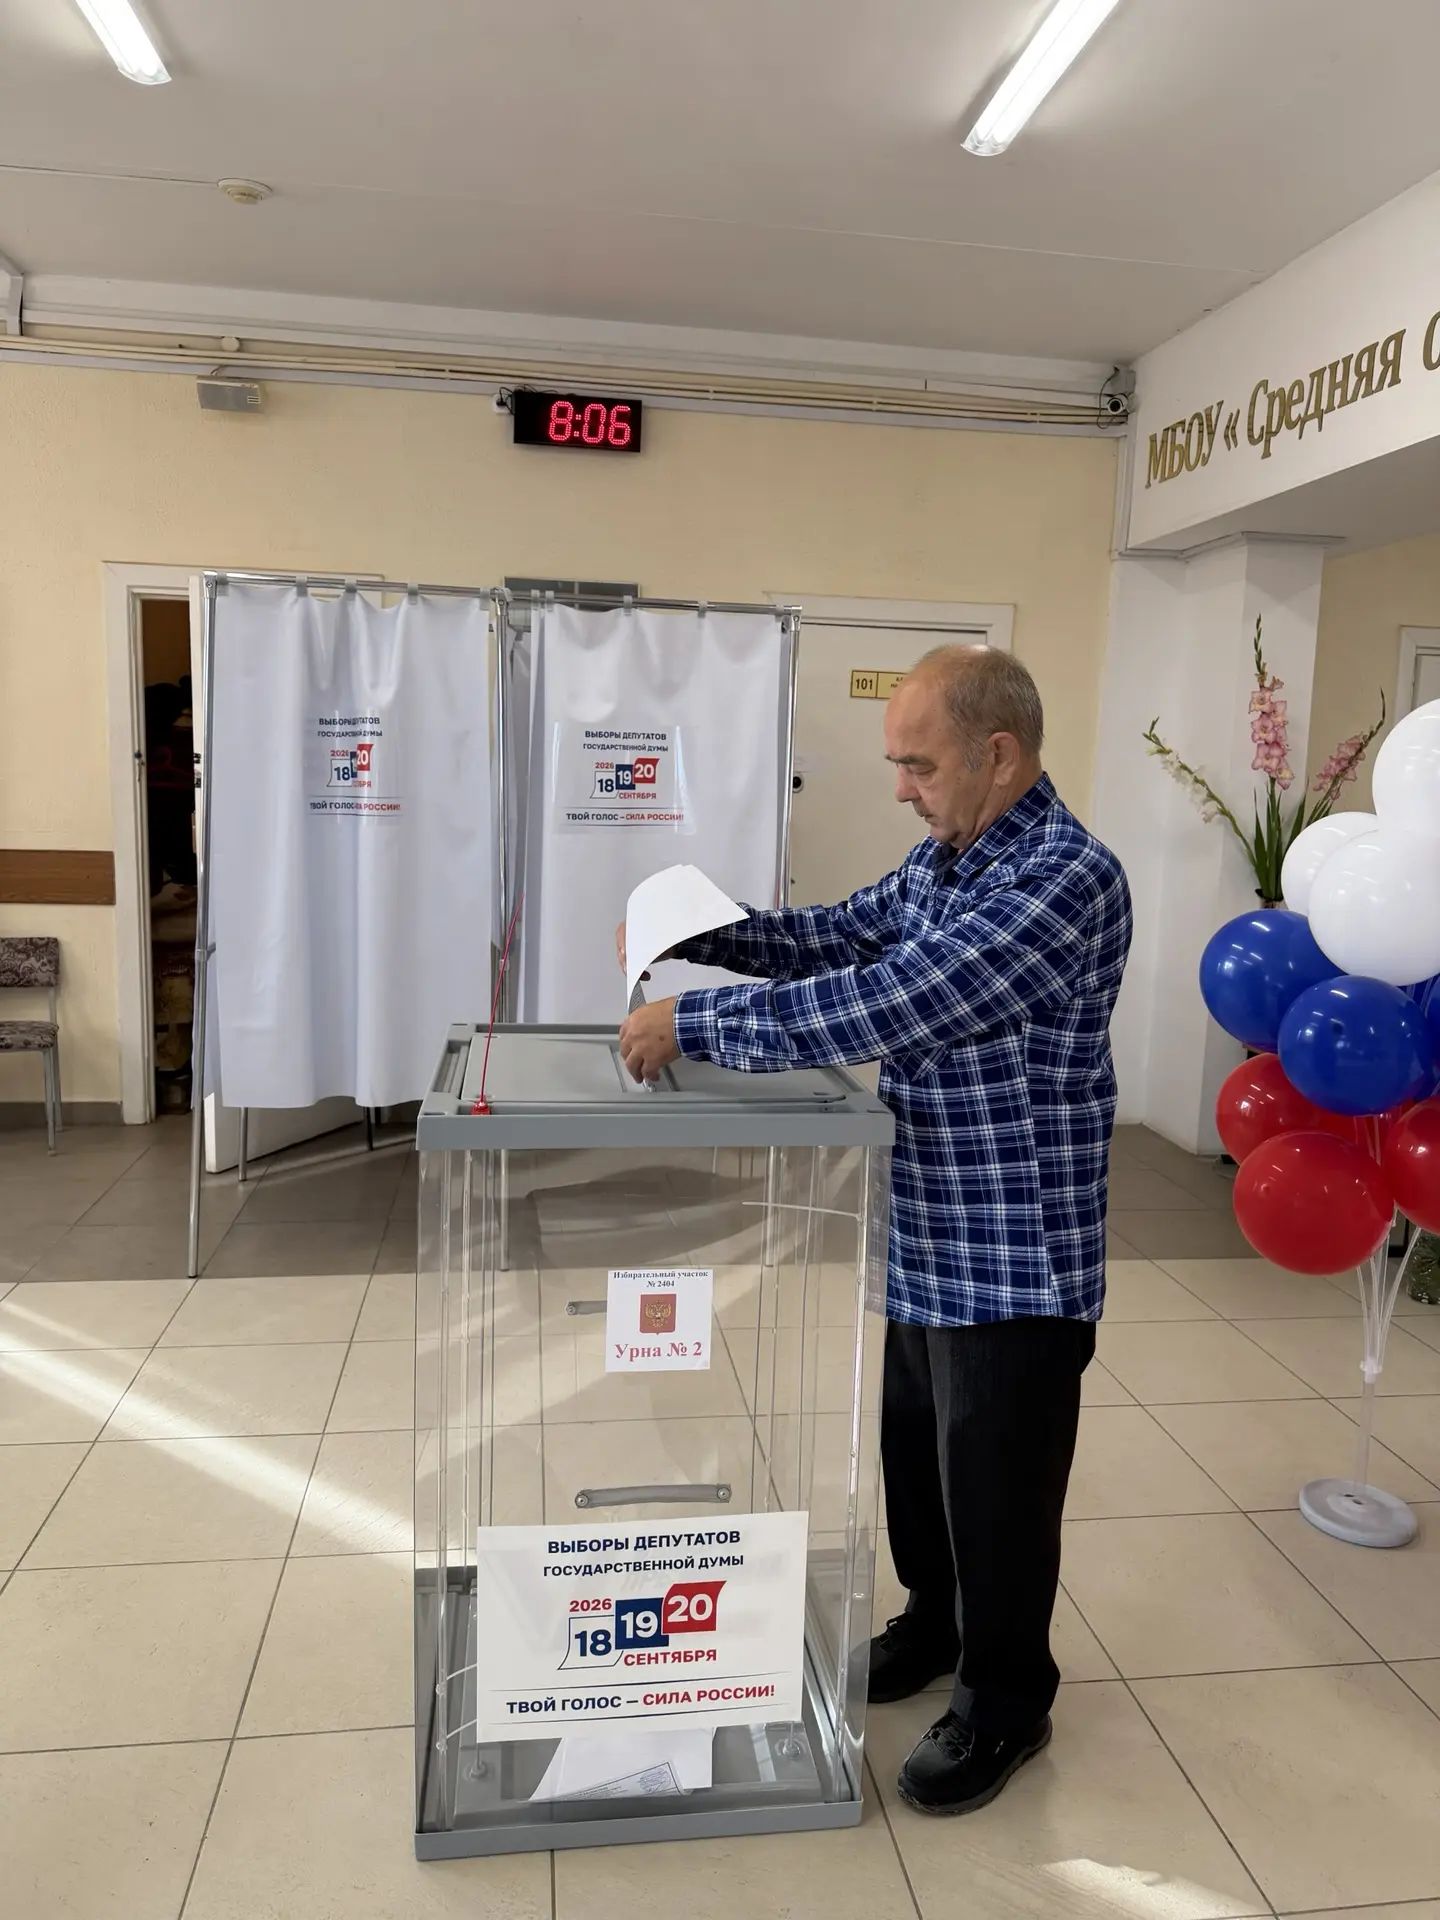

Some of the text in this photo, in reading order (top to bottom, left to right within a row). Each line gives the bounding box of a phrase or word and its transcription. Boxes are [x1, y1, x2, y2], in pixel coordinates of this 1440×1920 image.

[549, 400, 631, 446] 8:06
[1145, 400, 1224, 489] МБОУ
[855, 678, 873, 690] 101
[585, 731, 667, 741] ВЫБОРЫ ДЕПУТАТОВ
[583, 743, 669, 753] ГОСУДАРСТВЕННОЙ ДУМЫ
[334, 766, 350, 781] 18
[597, 764, 654, 792] 18 19 20
[618, 792, 656, 800] СЕНТЯБРЯ
[566, 812, 590, 821] ТВОЙ
[591, 813, 618, 821] ГОЛОС
[647, 813, 684, 821] РОССИИ!
[613, 1271, 709, 1280] Избирательный участок
[646, 1280, 675, 1288] № 2404
[615, 1341, 702, 1362] Урна № 2
[548, 1530, 740, 1553] ВЫБОРЫ ДЕПУТАТОВ
[543, 1555, 744, 1577] ГОСУДАРСТВЕННОЙ ДУМЫ
[569, 1598, 612, 1612] 2026
[574, 1593, 713, 1657] 18 19 20
[623, 1649, 717, 1667] СЕНТЯБРЯ
[506, 1696, 556, 1714] ТВОЙ
[561, 1696, 622, 1711] ГОЛОС
[642, 1691, 692, 1706] СИЛА
[696, 1685, 775, 1702] РОССИИ!
